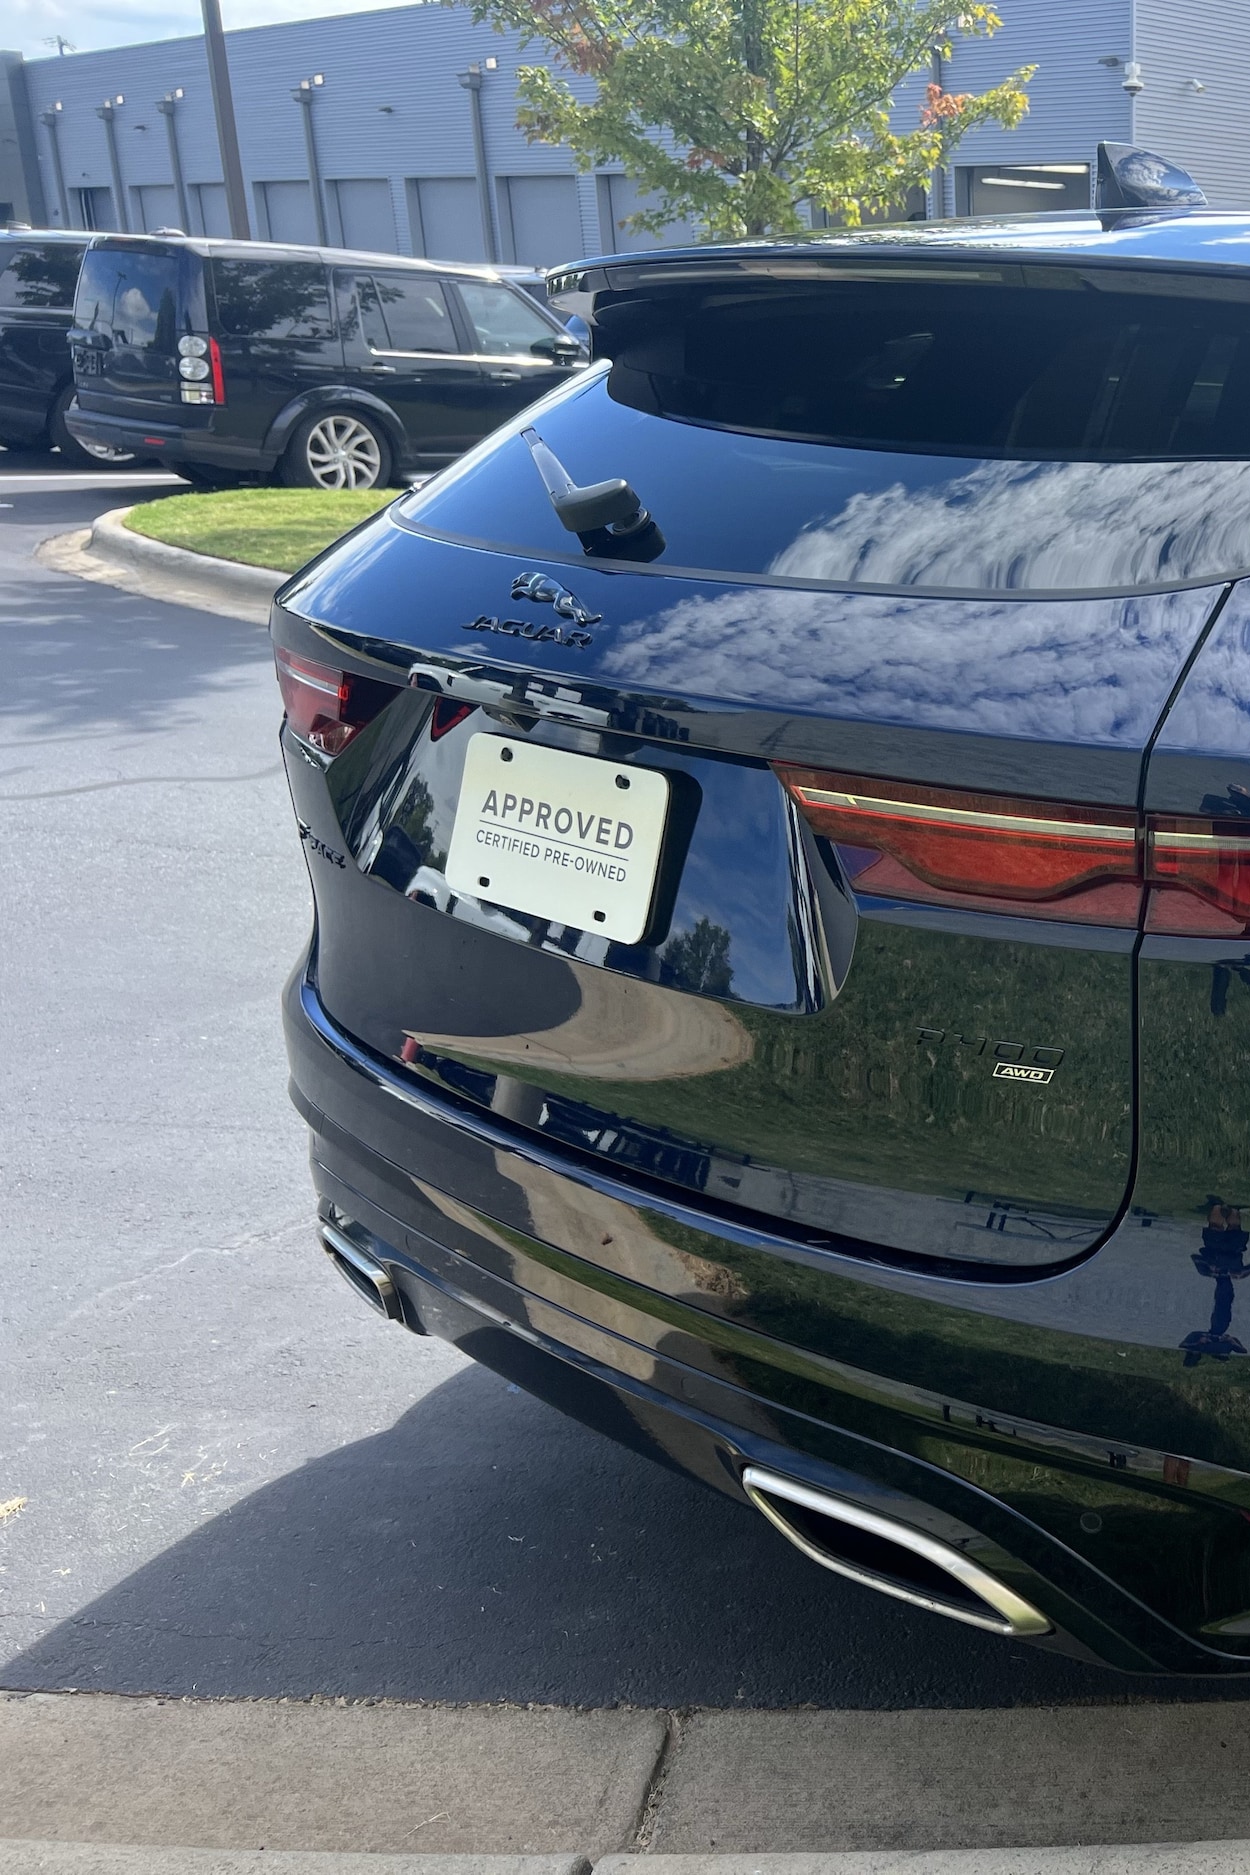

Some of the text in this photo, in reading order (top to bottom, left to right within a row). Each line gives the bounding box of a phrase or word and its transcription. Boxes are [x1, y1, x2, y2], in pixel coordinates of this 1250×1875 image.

[461, 614, 593, 649] JAGUAR
[481, 789, 634, 850] APPROVED
[476, 829, 627, 882] CERTIFIED PRE-OWNED
[1001, 1066, 1044, 1080] AWD
